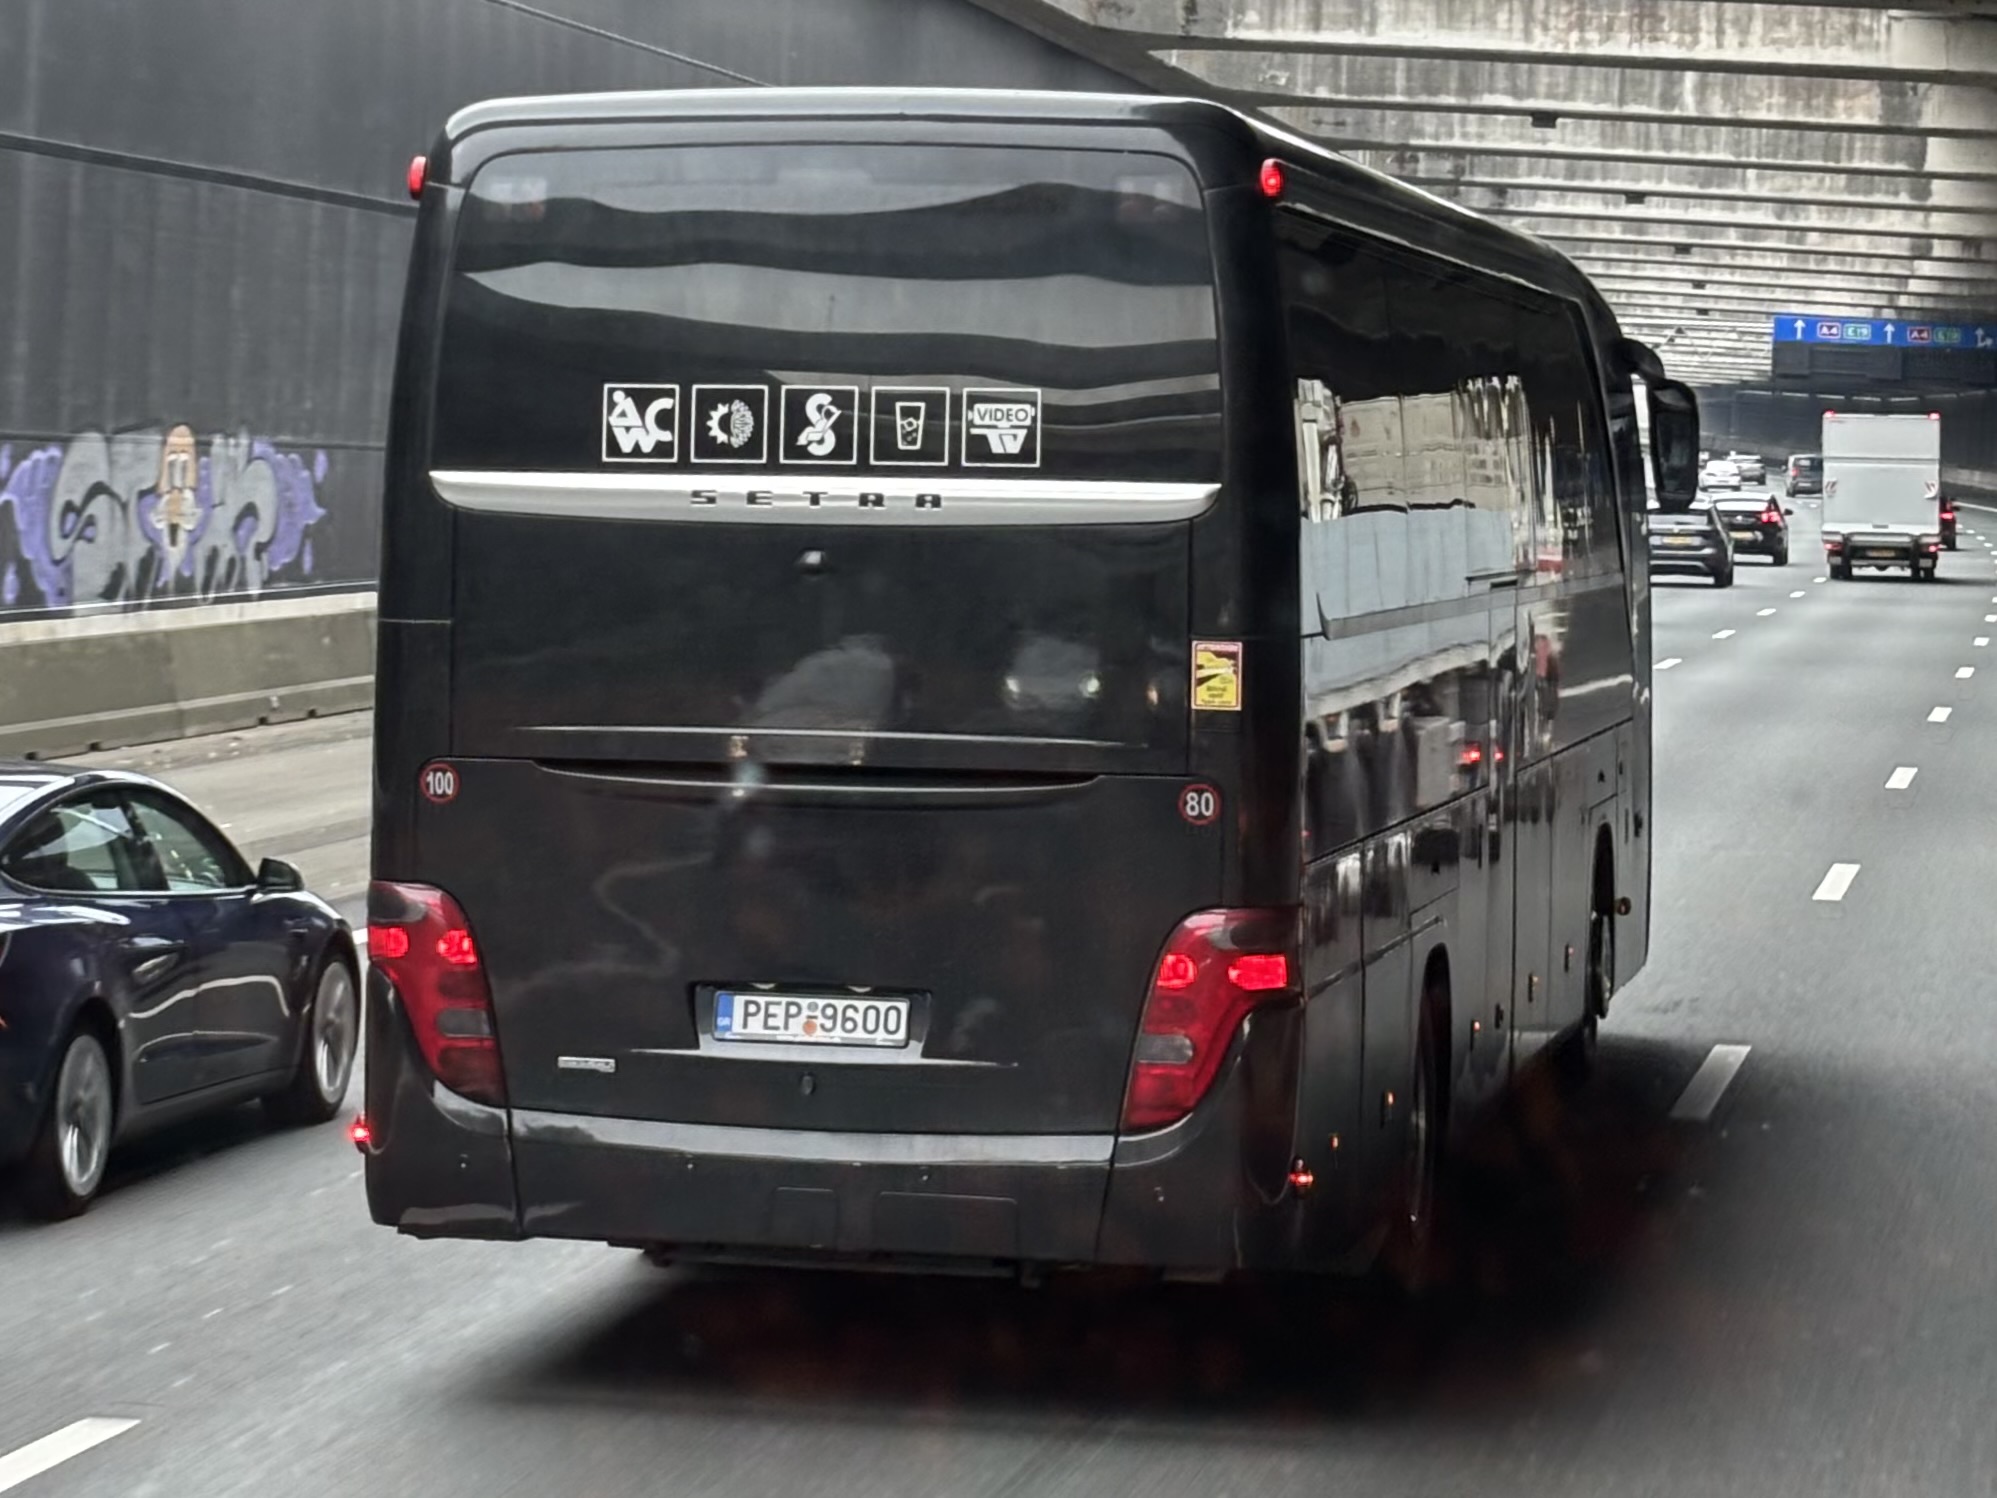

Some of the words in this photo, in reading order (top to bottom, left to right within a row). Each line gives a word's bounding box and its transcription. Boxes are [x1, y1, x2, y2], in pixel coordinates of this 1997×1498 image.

[976, 407, 1028, 422] VIDEO
[690, 489, 942, 509] SETRA
[426, 770, 454, 795] 100
[1186, 791, 1214, 817] 80
